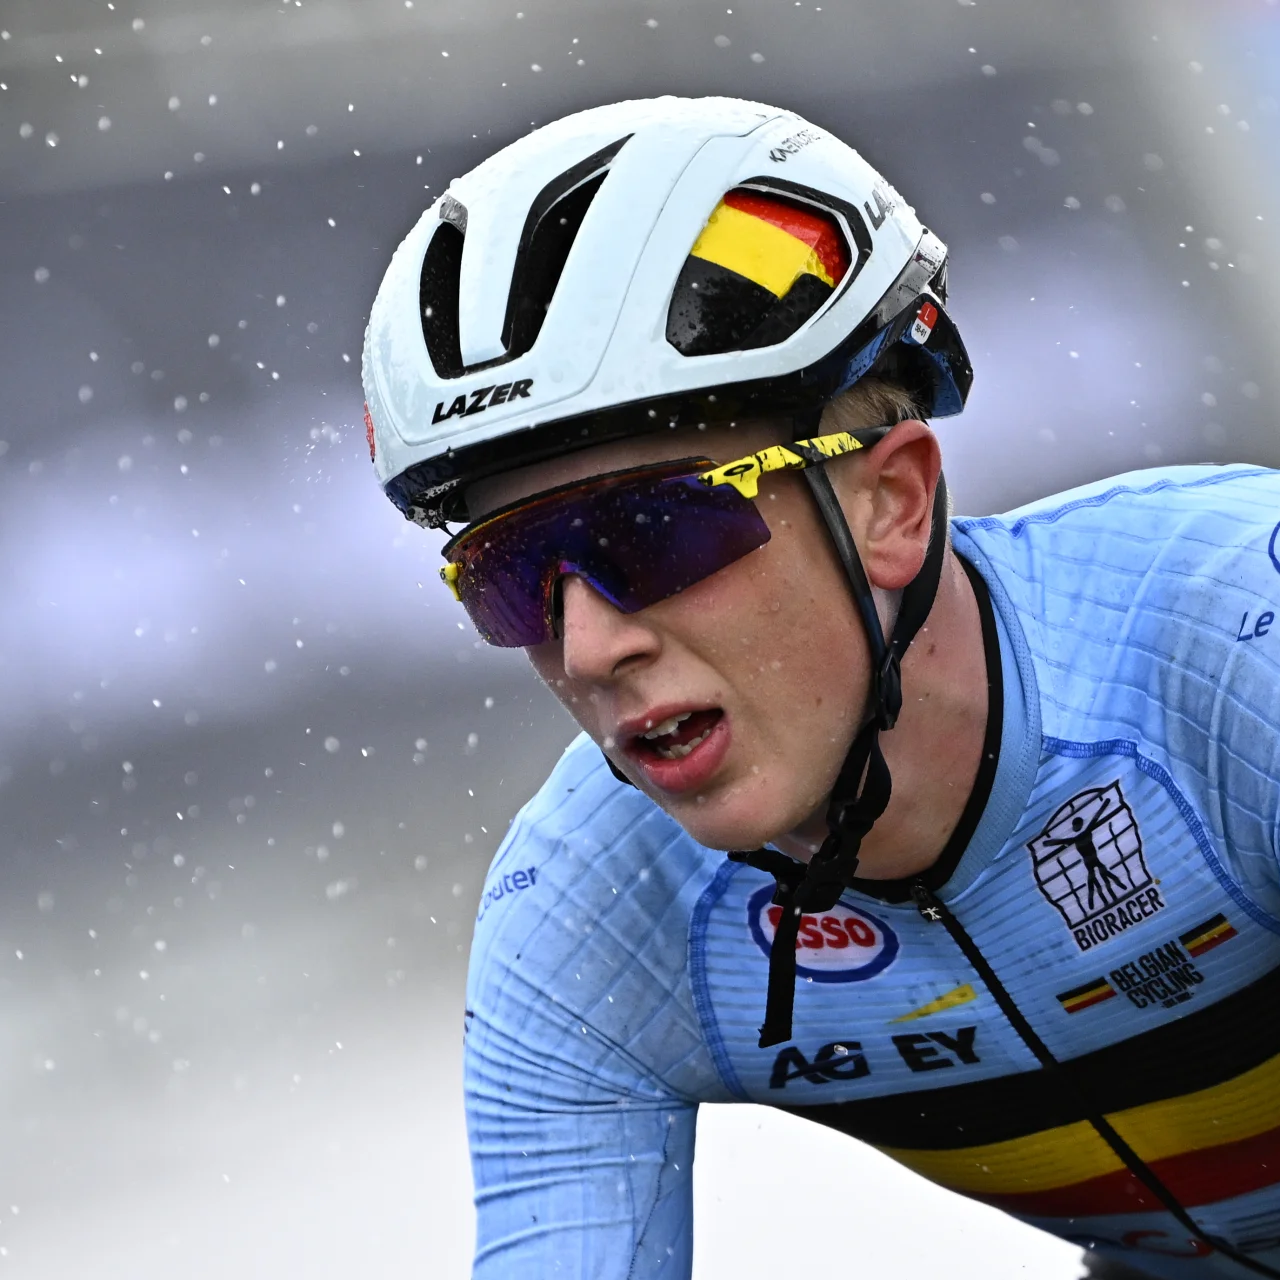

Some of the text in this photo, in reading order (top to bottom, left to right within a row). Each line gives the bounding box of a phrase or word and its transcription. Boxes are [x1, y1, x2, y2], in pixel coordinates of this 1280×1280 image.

[431, 378, 534, 425] LAZER
[1236, 610, 1276, 642] Le
[1073, 887, 1165, 951] BIORACER
[1109, 940, 1188, 992] BELGIAN
[1126, 963, 1205, 1009] CYCLING
[769, 1041, 871, 1089] AG
[891, 1026, 980, 1073] EY
